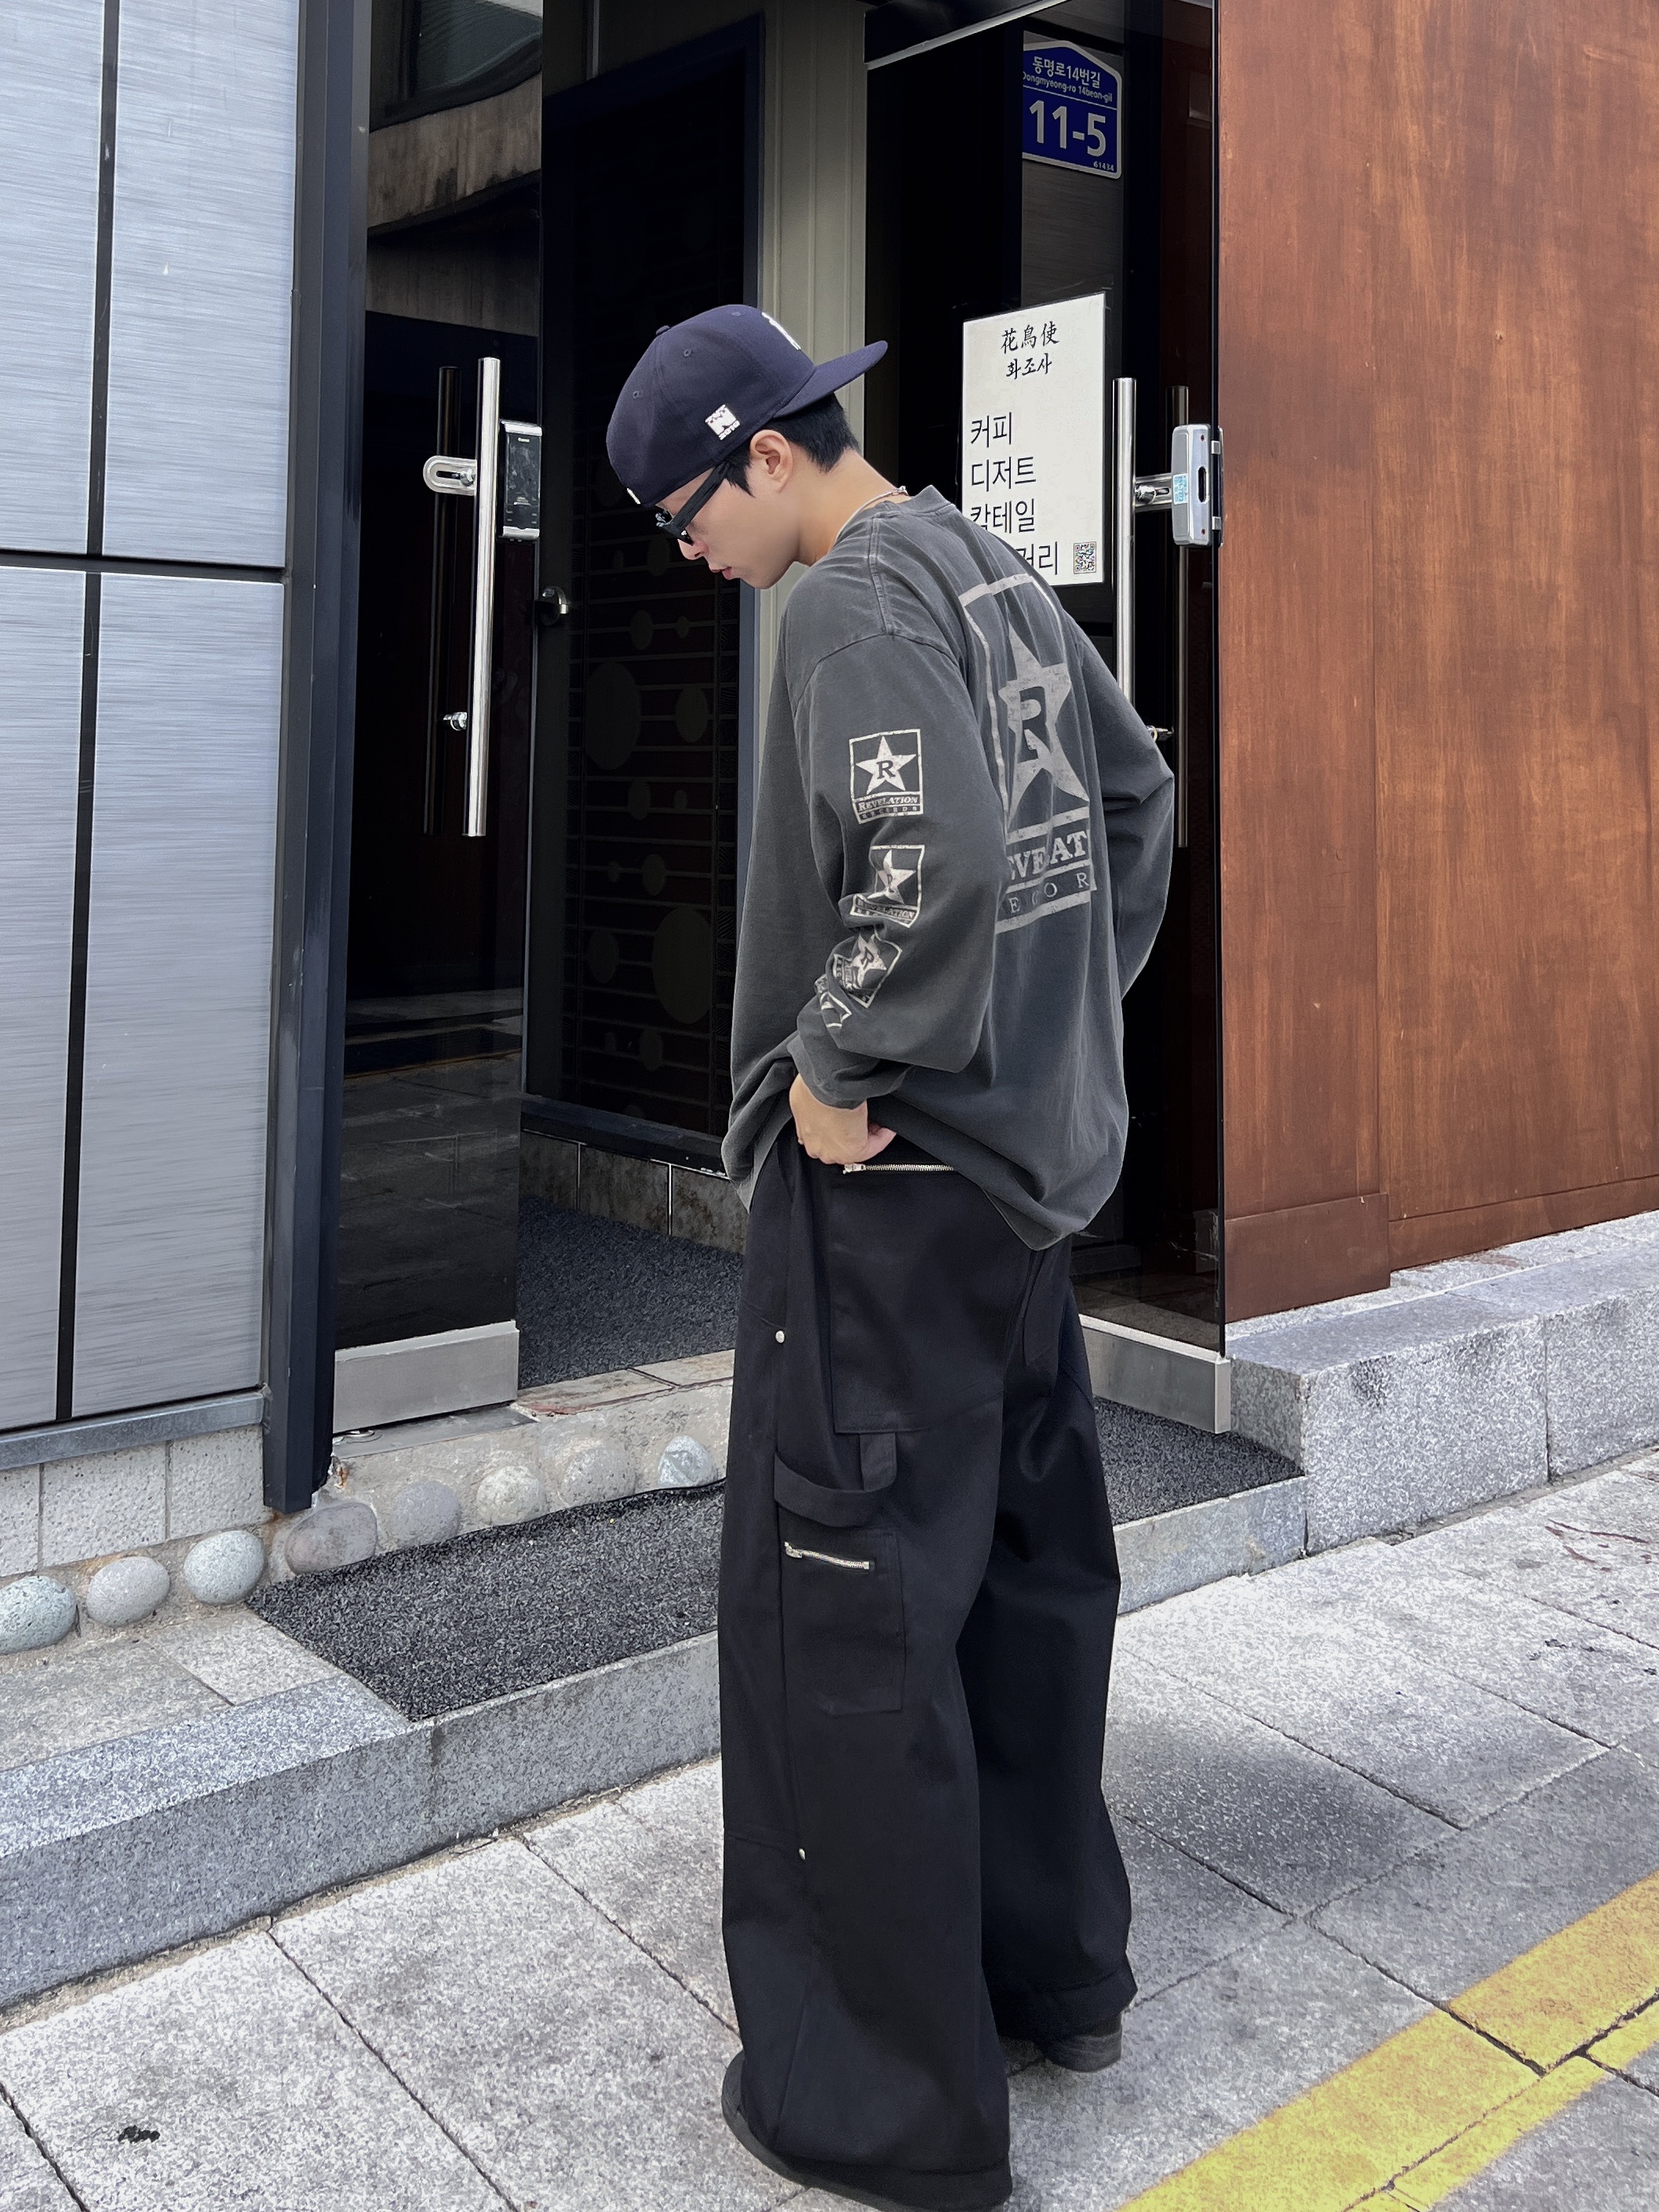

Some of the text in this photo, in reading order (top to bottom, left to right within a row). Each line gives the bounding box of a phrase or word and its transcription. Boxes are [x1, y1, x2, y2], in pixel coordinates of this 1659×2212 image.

[1032, 56, 1101, 89] 동명로14번길
[1029, 100, 1107, 157] 11-5
[1093, 160, 1115, 172] 61434
[1001, 321, 1060, 355] 花鳥使
[1005, 353, 1053, 381] 화조사
[970, 411, 1014, 448] 커피
[971, 455, 1037, 493] 디저트
[877, 760, 896, 779] R
